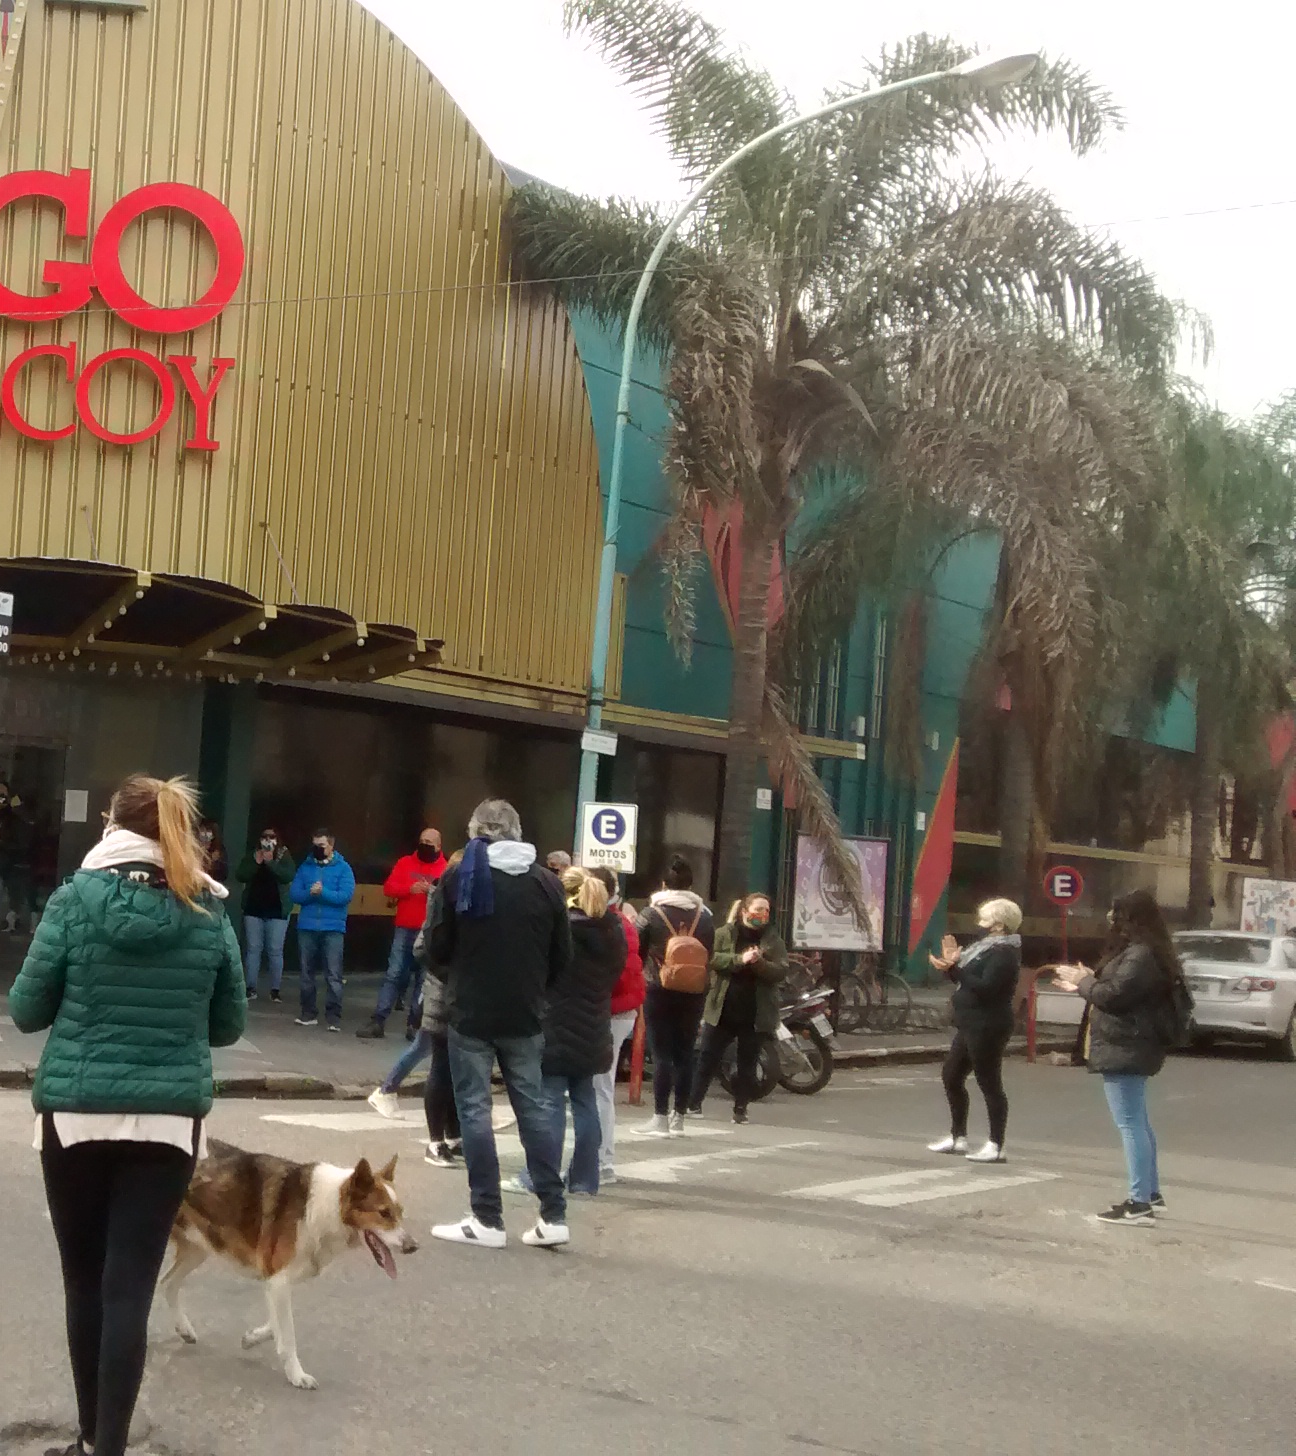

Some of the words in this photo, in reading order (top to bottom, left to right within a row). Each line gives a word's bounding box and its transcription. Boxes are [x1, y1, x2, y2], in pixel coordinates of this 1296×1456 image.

[600, 815, 617, 839] E
[589, 849, 627, 859] MOTOS
[1055, 875, 1072, 897] E
